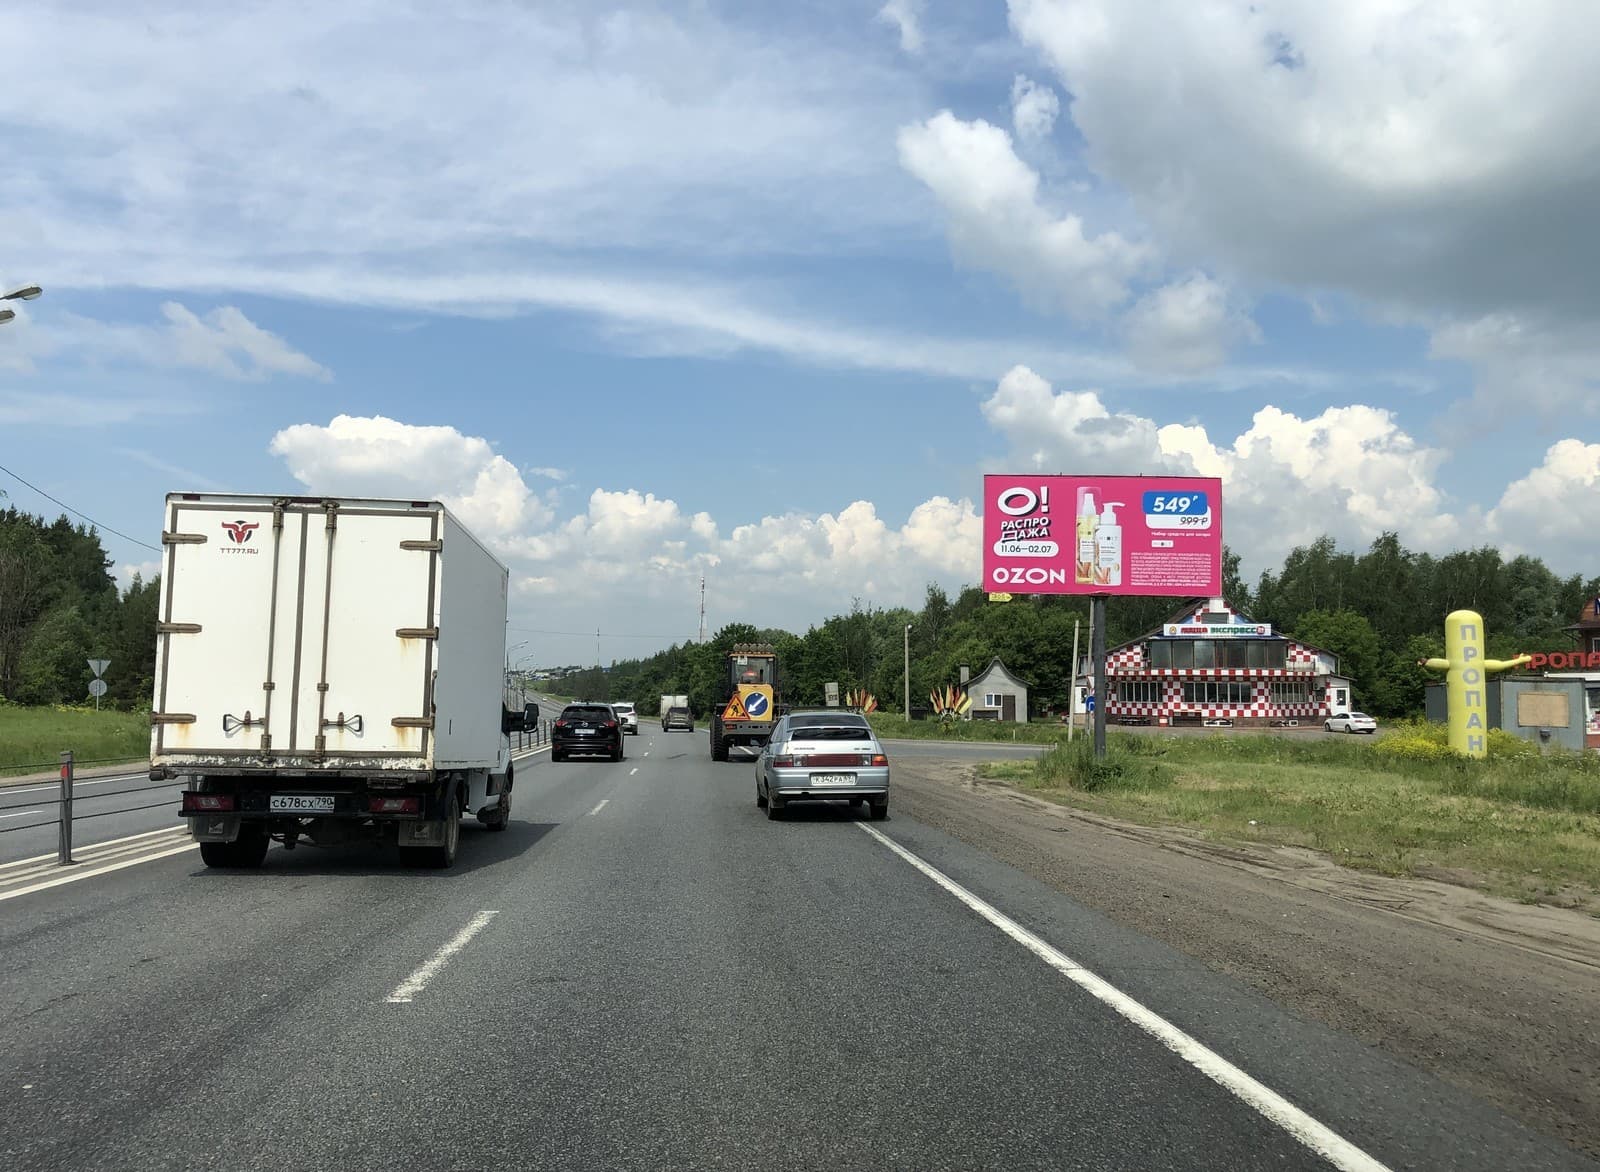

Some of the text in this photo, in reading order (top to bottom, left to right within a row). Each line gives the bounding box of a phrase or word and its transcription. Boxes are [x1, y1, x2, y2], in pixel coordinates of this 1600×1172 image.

[998, 486, 1049, 516] О!
[1153, 496, 1191, 513] 549
[1001, 516, 1050, 530] РАСПРО
[1179, 516, 1200, 526] 999
[1000, 527, 1050, 542] ДАЖА
[993, 567, 1066, 584] OZON
[1460, 624, 1483, 752] ПРОПАН
